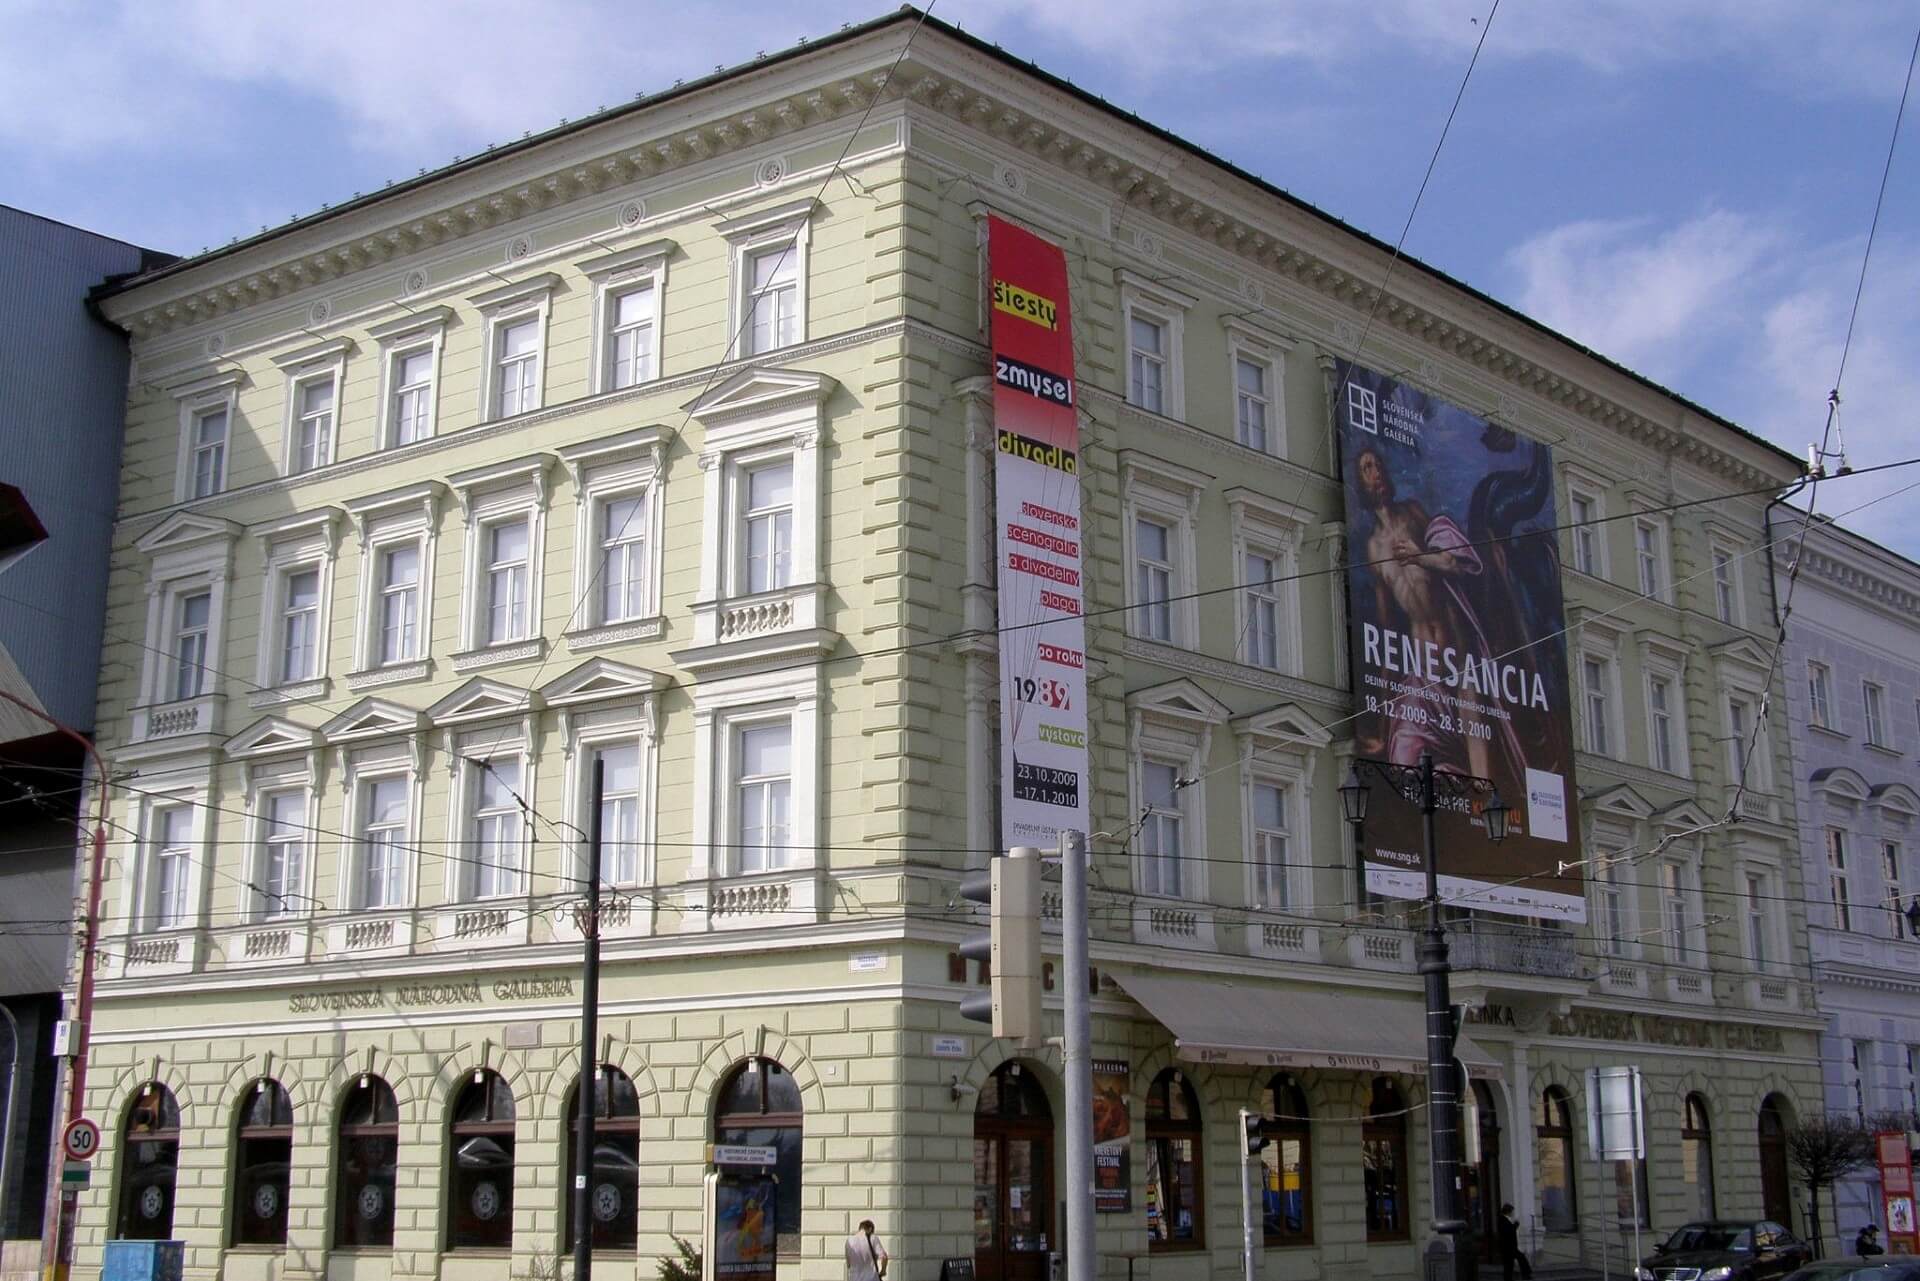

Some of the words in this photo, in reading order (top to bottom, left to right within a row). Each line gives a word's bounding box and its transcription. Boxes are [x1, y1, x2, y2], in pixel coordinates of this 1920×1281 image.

[994, 280, 1057, 329] šiesty
[996, 361, 1073, 404] zmysel
[999, 431, 1077, 475] divadla
[1010, 556, 1018, 568] a
[1056, 649, 1082, 665] roku
[1363, 622, 1550, 712] RENESANCIA
[1014, 676, 1074, 711] 1989
[1364, 674, 1389, 689] DEJINY
[1365, 694, 1380, 713] 18.
[1384, 700, 1398, 719] 12.
[1401, 704, 1427, 725] 2009
[1439, 714, 1455, 731] 28.
[1457, 718, 1466, 734] 3.
[1469, 720, 1492, 741] 2010
[1017, 765, 1033, 779] 23.
[1036, 768, 1050, 783] 10.
[1052, 771, 1076, 787] 2009
[1052, 792, 1077, 807] 2010
[1375, 848, 1421, 865] www.sng.sk
[289, 985, 384, 1013] SLOVENSKÁ
[395, 979, 483, 1006] NÁRODNÁ
[493, 974, 575, 1001] GALÉRIA
[72, 1130, 91, 1149] 50
